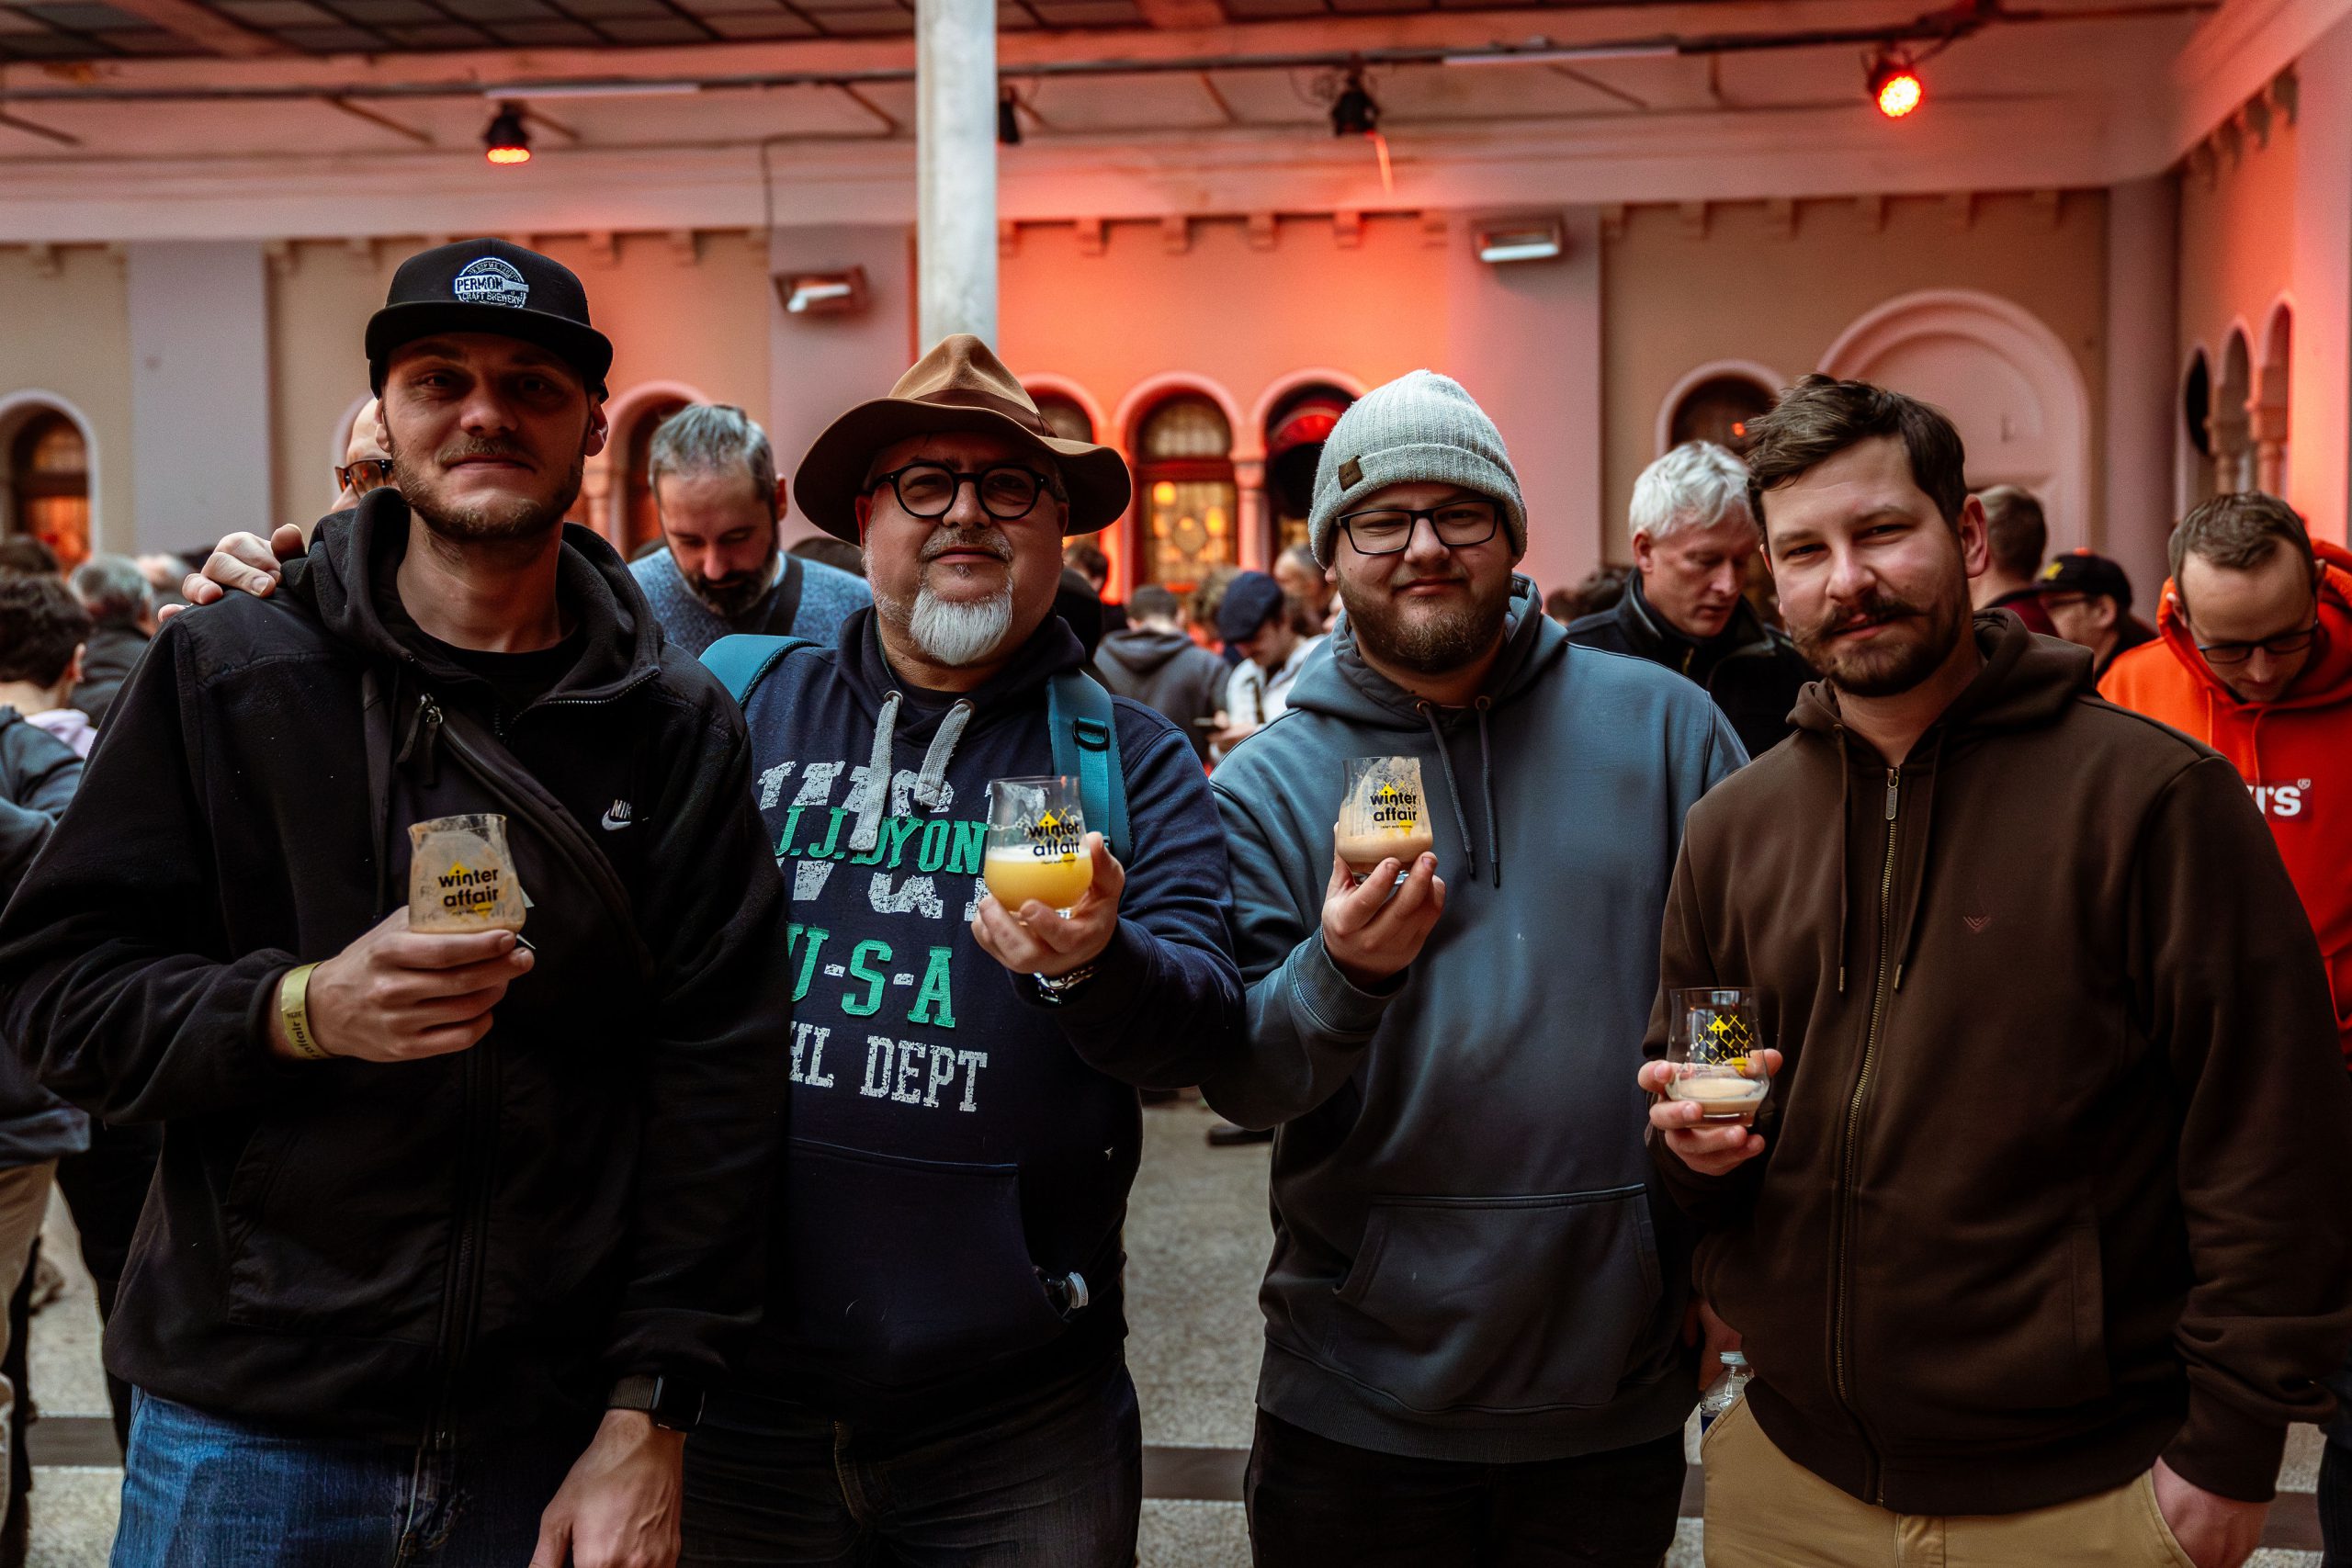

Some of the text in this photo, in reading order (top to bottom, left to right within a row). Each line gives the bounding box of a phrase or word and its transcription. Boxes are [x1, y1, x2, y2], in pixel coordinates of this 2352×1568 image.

[462, 292, 522, 305] CRAFT BREWERY
[1369, 790, 1417, 806] winter
[1373, 806, 1418, 822] affair
[1028, 820, 1080, 839] winter
[1033, 837, 1080, 857] affair
[437, 868, 499, 888] winter
[443, 886, 499, 908] affair
[859, 1034, 989, 1112] DEPT
